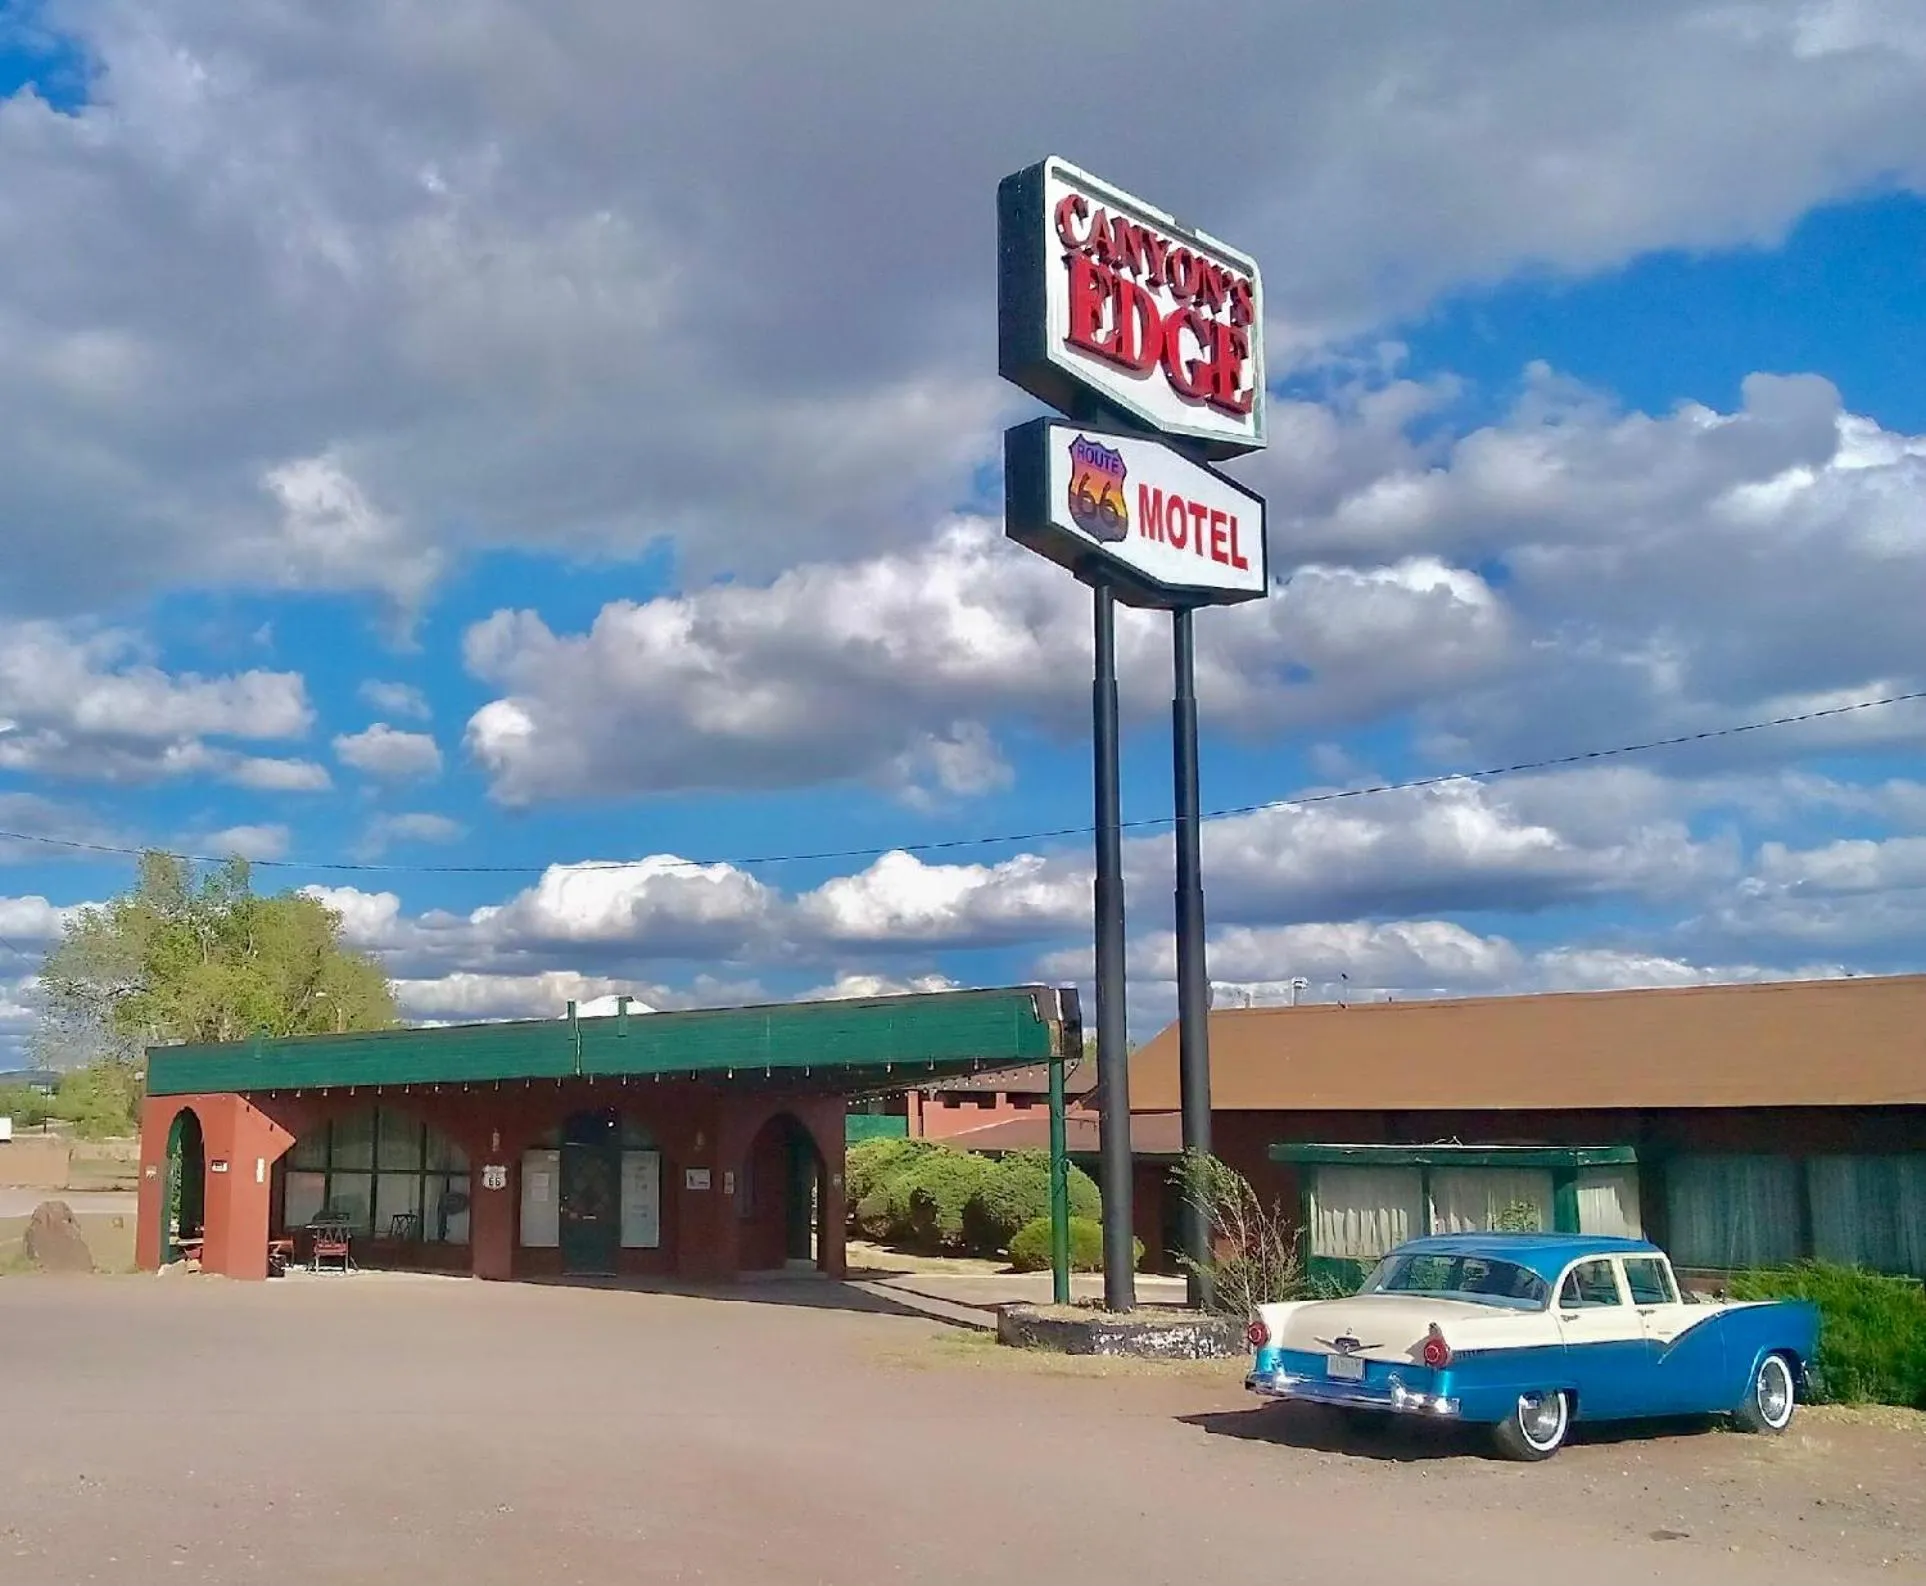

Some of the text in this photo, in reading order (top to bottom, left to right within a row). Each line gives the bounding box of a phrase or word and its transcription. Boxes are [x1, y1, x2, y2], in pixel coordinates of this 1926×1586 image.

[1055, 193, 1254, 327] CANYON'S
[1063, 251, 1253, 416] EDGE
[1077, 444, 1120, 473] ROUTE
[1078, 472, 1119, 526] 66
[1138, 483, 1249, 571] MOTEL
